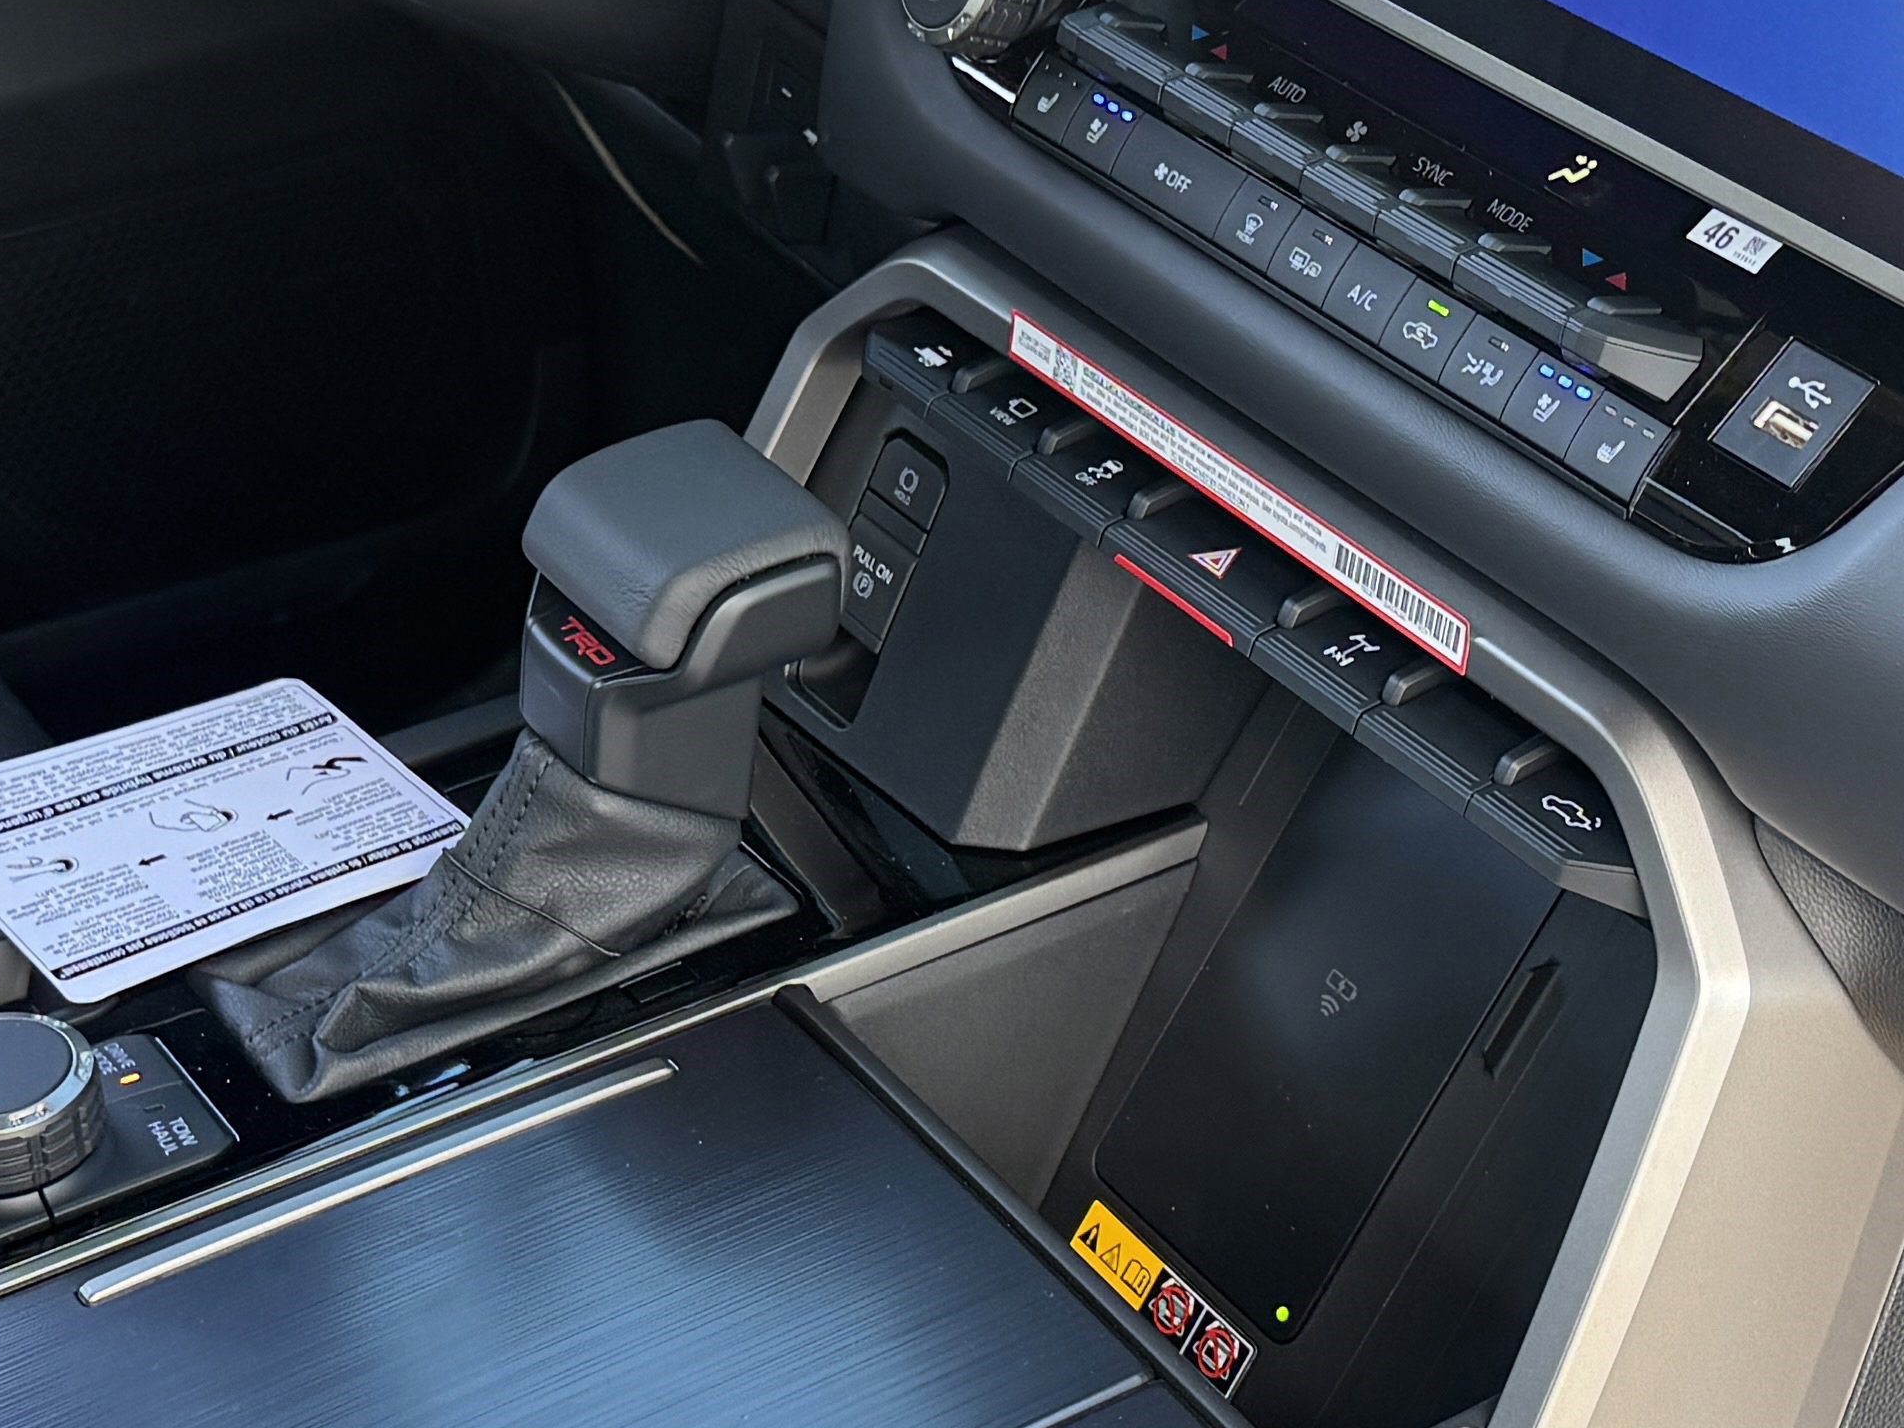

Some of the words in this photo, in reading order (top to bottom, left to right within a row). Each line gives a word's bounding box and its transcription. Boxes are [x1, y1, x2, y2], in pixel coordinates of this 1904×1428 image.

[1267, 75, 1307, 104] AUTO
[1166, 169, 1192, 193] OFF
[1412, 156, 1454, 187] SYNC
[1486, 198, 1533, 233] MODE
[1703, 220, 1740, 250] 46
[1347, 283, 1378, 312] A/C
[989, 406, 1016, 426] VIEW
[1075, 472, 1098, 486] OFF
[853, 544, 876, 571] PULL
[875, 563, 894, 584] ON
[560, 615, 616, 666] TRD
[277, 725, 303, 738] du
[206, 749, 230, 762] du
[103, 1042, 136, 1070] DRIVE
[147, 1120, 179, 1156] HAUL
[169, 1116, 198, 1146] TOW
